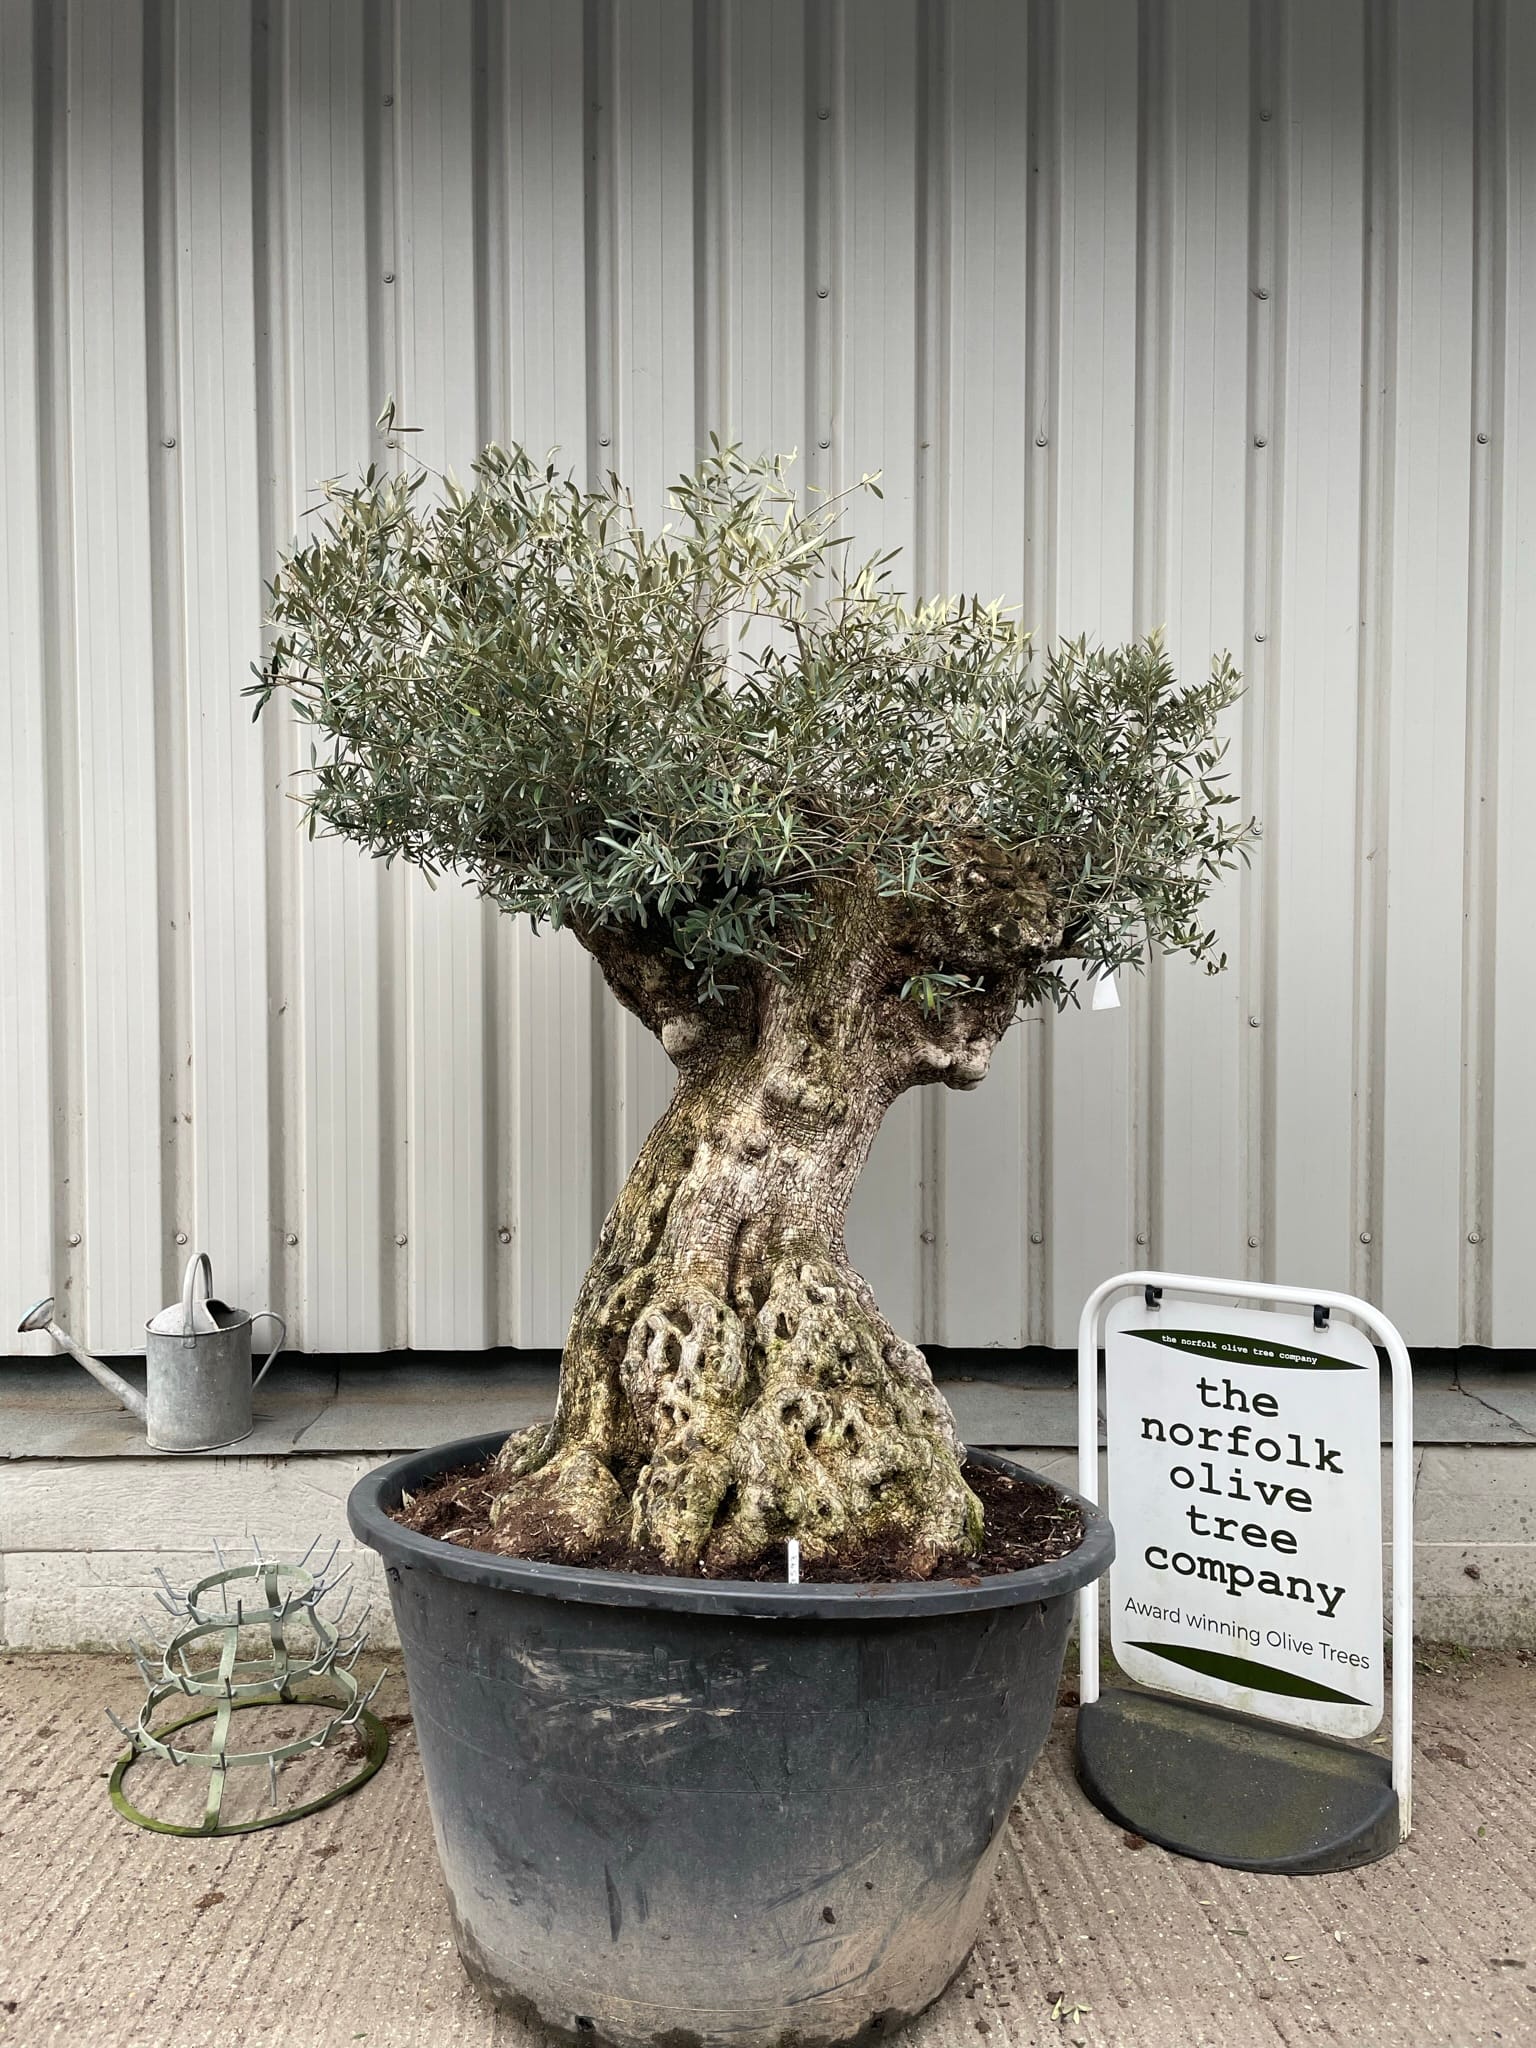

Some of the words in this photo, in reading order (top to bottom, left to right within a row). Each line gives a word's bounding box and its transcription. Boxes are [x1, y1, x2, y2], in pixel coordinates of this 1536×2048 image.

[1161, 1334, 1177, 1344] the
[1181, 1336, 1217, 1350] norfolk
[1221, 1343, 1249, 1354] olive
[1253, 1347, 1275, 1358] tree
[1278, 1351, 1319, 1365] company
[1195, 1376, 1279, 1418] the
[1140, 1417, 1344, 1474] norfolk
[1169, 1461, 1313, 1513] olive
[1185, 1504, 1298, 1555] tree
[1144, 1545, 1346, 1619] company
[1124, 1597, 1181, 1625] Award
[1185, 1613, 1260, 1647] winning
[1266, 1630, 1314, 1656] Olive
[1318, 1641, 1370, 1670] Trees
